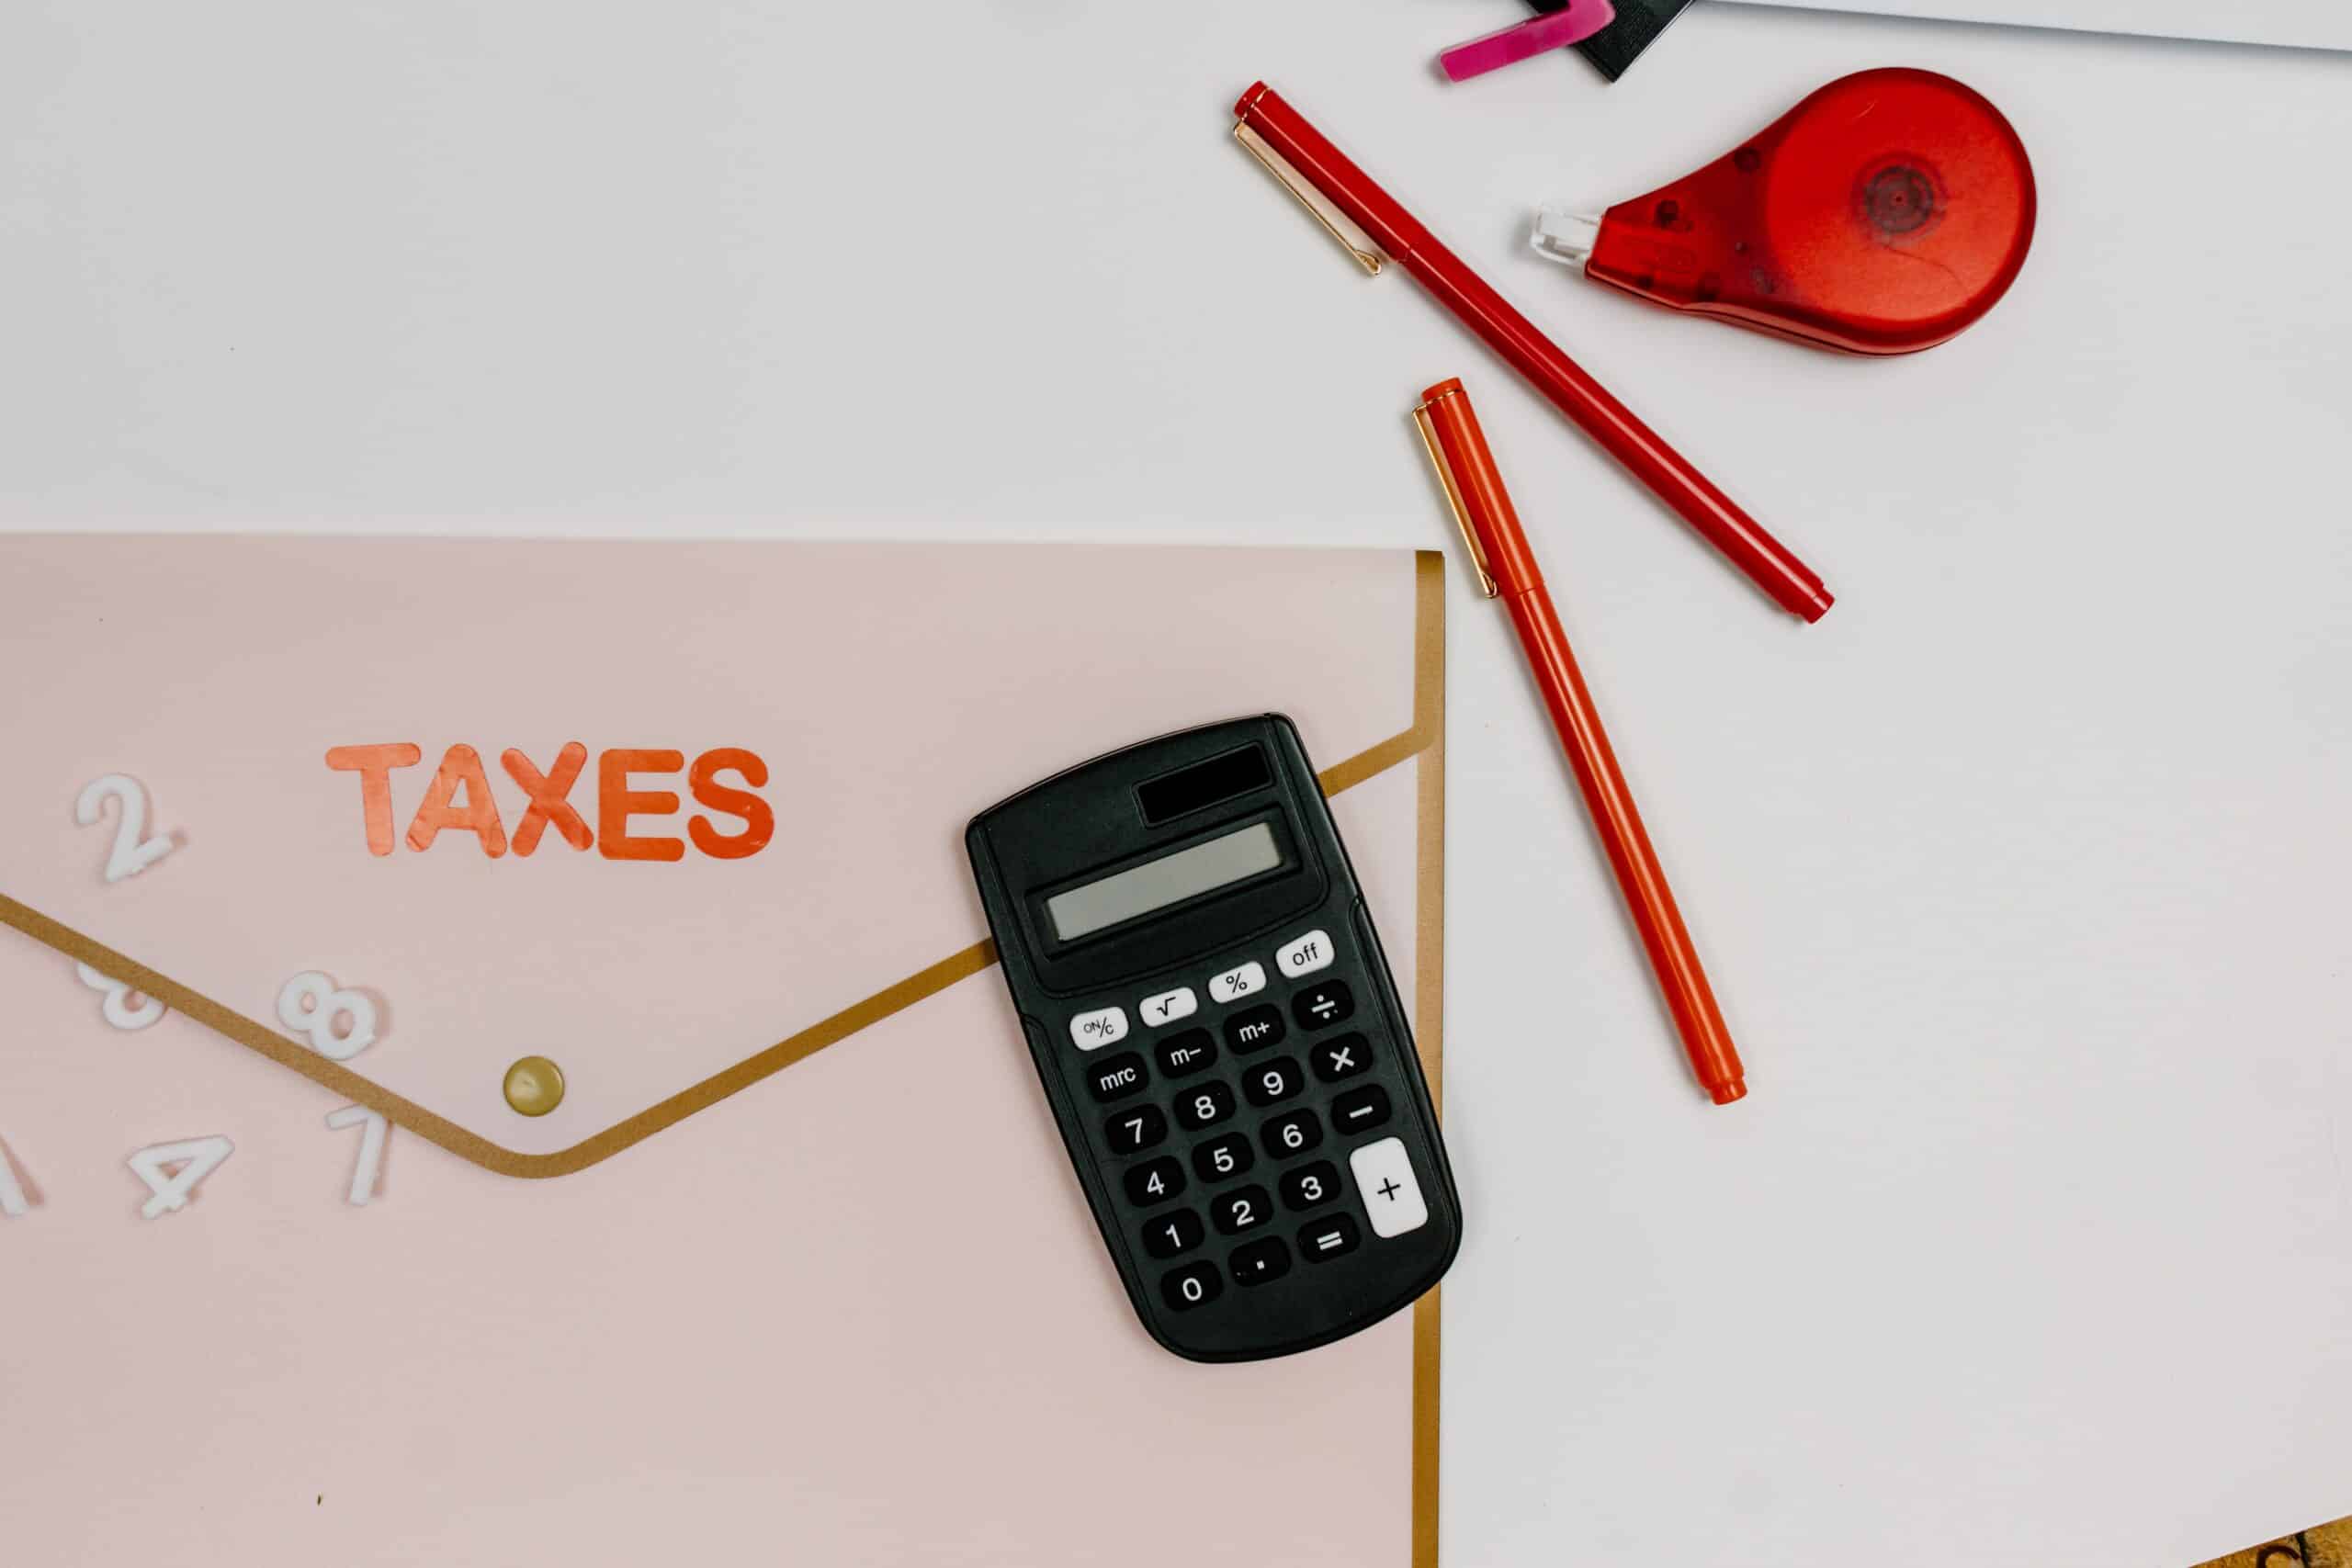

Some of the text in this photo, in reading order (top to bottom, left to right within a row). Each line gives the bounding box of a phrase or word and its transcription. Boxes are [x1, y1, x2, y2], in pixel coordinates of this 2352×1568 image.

[325, 741, 775, 860] TAXES
[75, 773, 173, 884] 2
[1292, 942, 1320, 966] off
[1225, 972, 1249, 994] %
[277, 970, 377, 1060] 8
[1100, 1066, 1136, 1092] mrc
[1263, 1071, 1283, 1096] 9
[1194, 1095, 1216, 1120] 8
[1125, 1118, 1143, 1144] 7
[1283, 1123, 1303, 1148] 6
[1214, 1146, 1234, 1172] 5
[126, 1134, 235, 1220] 4
[1147, 1171, 1165, 1195] 4
[1301, 1176, 1322, 1201] 3
[1232, 1200, 1254, 1226] 2
[1166, 1224, 1182, 1247] 1
[1182, 1278, 1203, 1302] 0
